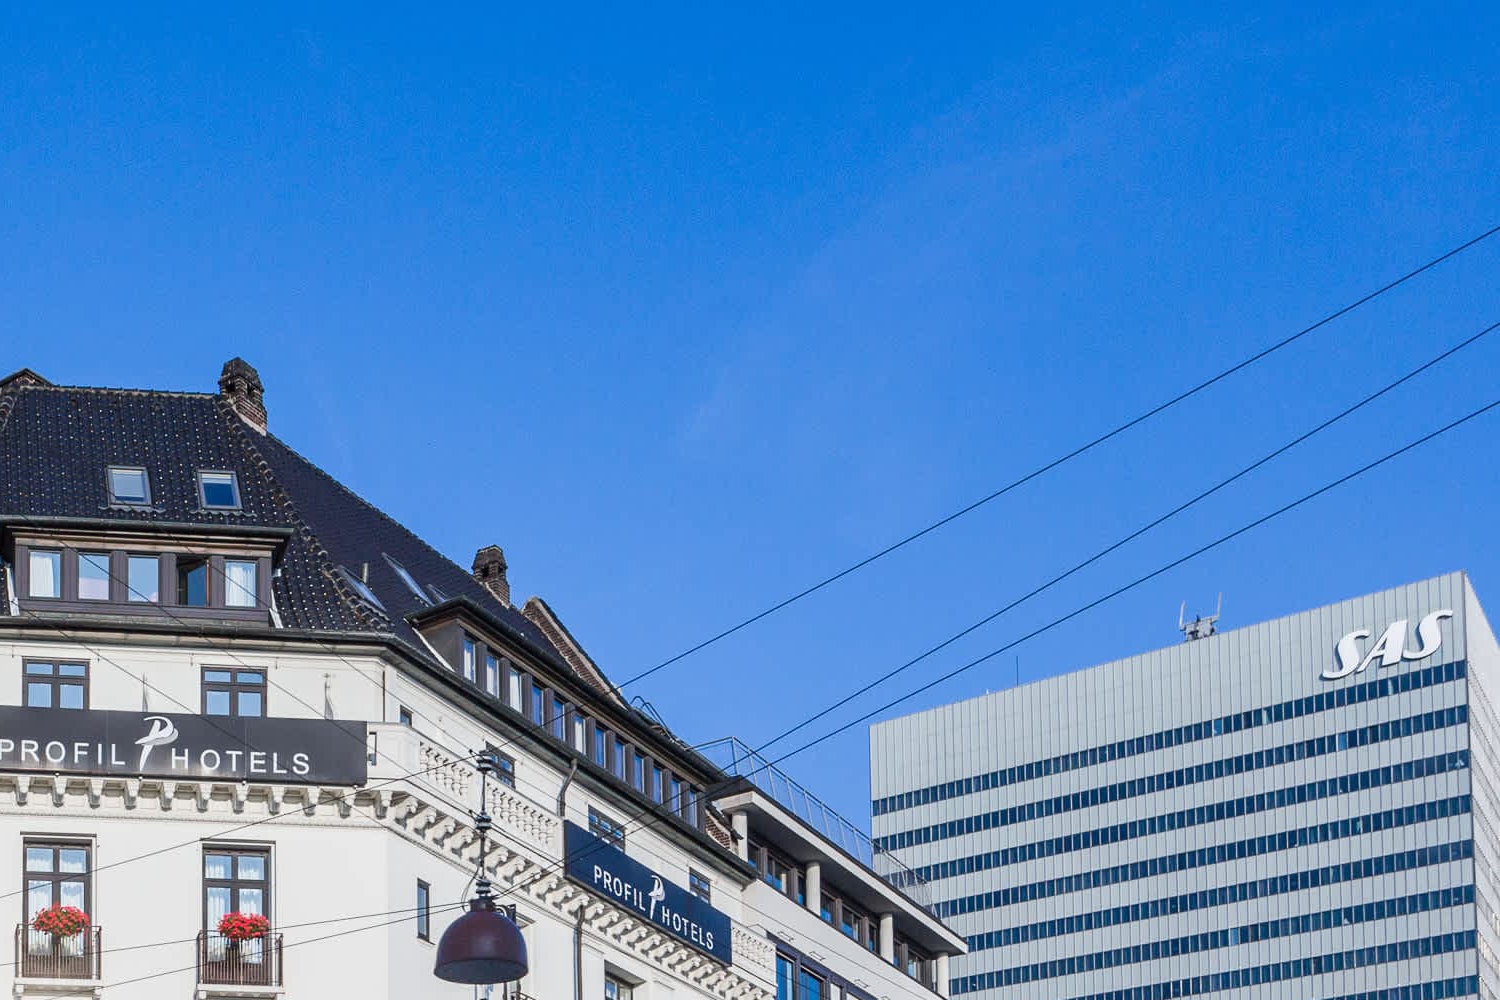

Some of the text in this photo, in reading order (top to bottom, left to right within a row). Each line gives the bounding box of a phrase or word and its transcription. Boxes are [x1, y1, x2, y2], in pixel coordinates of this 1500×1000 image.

[1320, 609, 1453, 680] SAS
[171, 747, 310, 774] HOTELS
[593, 865, 646, 911] PROFIL
[662, 908, 714, 950] HOTELS
